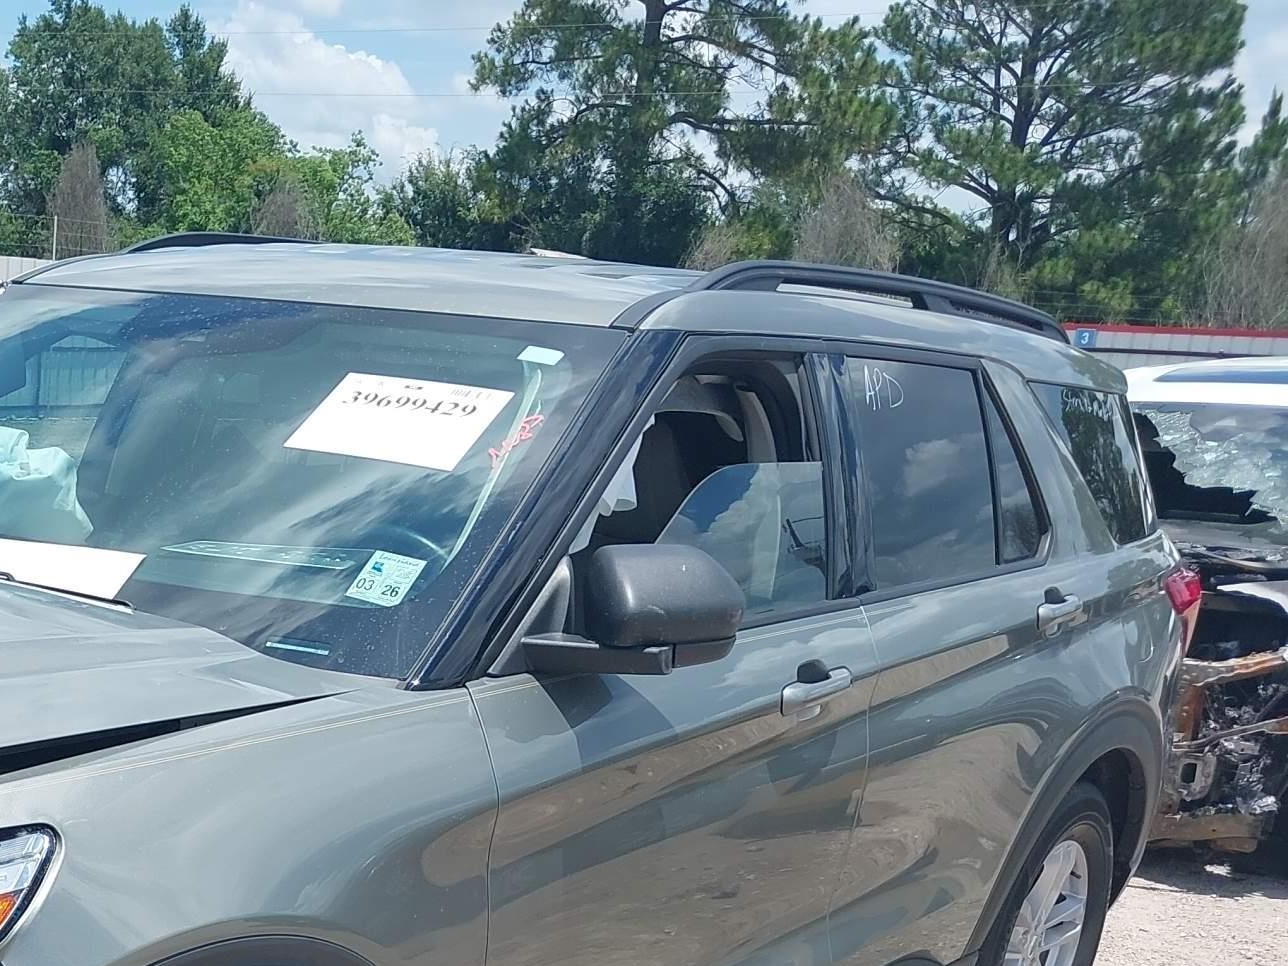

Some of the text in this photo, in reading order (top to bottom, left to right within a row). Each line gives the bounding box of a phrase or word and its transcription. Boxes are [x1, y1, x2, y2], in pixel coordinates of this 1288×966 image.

[1081, 332, 1090, 345] 3
[343, 390, 478, 417] 39699429
[355, 577, 376, 591] 03
[380, 584, 401, 598] 26
